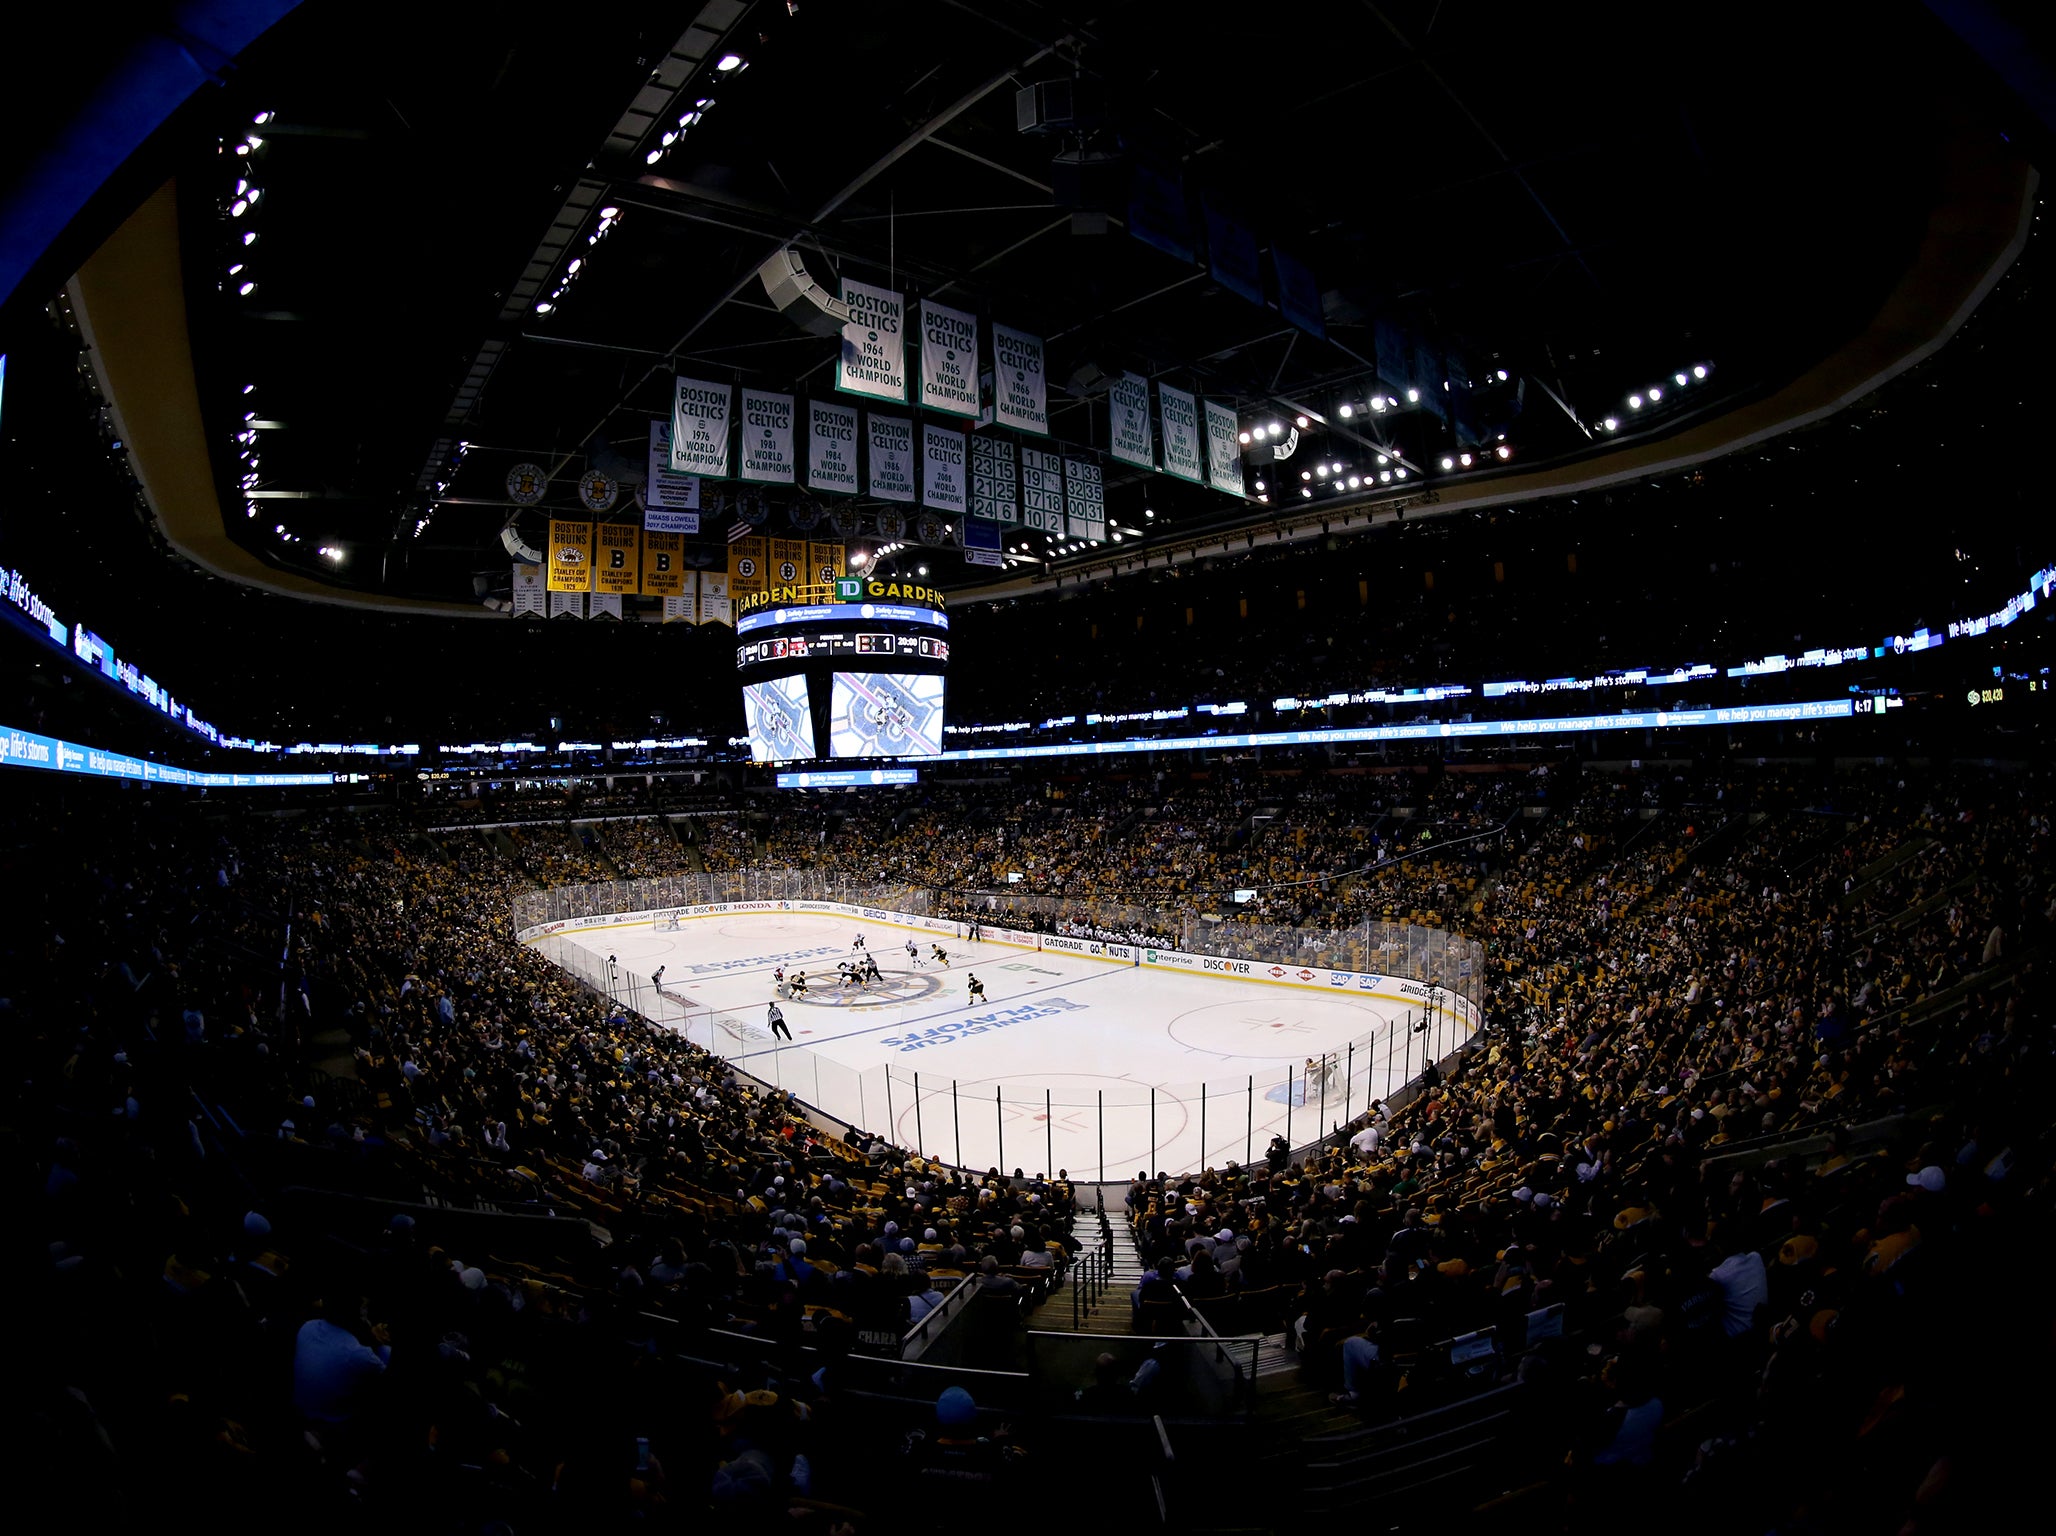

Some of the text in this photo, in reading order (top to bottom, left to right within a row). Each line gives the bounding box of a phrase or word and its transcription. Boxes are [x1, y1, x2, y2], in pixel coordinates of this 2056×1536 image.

[846, 290, 899, 317] BOSTON
[849, 308, 898, 334] CELTICS
[926, 311, 973, 338] BOSTON
[927, 328, 972, 353] CELTICS
[997, 334, 1041, 359] BOSTON
[862, 342, 883, 357] 1964
[856, 354, 891, 372] WORLD
[941, 361, 961, 375] 1965
[1000, 351, 1040, 374] CELTICS
[846, 366, 902, 387] CHAMPIONS
[935, 372, 966, 390] WORLD
[680, 387, 727, 406] BOSTON
[926, 382, 976, 404] CHAMPIONS
[1012, 382, 1030, 395] 1966
[746, 399, 790, 416] BOSTON
[1008, 392, 1036, 409] WORLD
[1113, 390, 1146, 411] CELTICS
[1162, 392, 1193, 414] BOSTON
[681, 402, 724, 420] CELTICS
[813, 409, 854, 428] BOSTON
[1000, 402, 1046, 423] CHAMPIONS
[1164, 407, 1193, 427] CELTICS
[748, 412, 789, 429] CELTICS
[1208, 411, 1236, 431] BOSTON
[692, 430, 710, 441] 1976
[815, 423, 852, 441] CELTICS
[871, 421, 910, 439] BOSTON
[1121, 428, 1144, 444] WORLD
[1210, 425, 1237, 443] CELTICS
[686, 440, 716, 454] WORLD
[760, 439, 776, 449] 1981
[873, 436, 909, 452] CELTICS
[927, 434, 963, 451] BOSTON
[972, 438, 1012, 459] 22 14
[1115, 437, 1151, 456] CHAMPIONS
[676, 451, 724, 466] CHAMPIONS
[754, 450, 783, 462] WORLD
[825, 450, 841, 461] 1984
[928, 449, 962, 465] CELTICS
[1027, 451, 1059, 471] 1 16
[745, 459, 791, 474] CHAMPIONS
[820, 460, 847, 472] WORLD
[884, 461, 900, 471] 1986
[974, 456, 1013, 478] 23 15
[1070, 462, 1100, 482] 3 33
[811, 468, 854, 484] CHAMPIONS
[880, 470, 905, 482] WORLD
[1025, 470, 1040, 486] 19
[872, 479, 913, 493] CHAMPIONS
[934, 481, 957, 493] WORLD
[976, 477, 1015, 499] 21 25
[1068, 481, 1084, 496] 32
[1086, 484, 1102, 499] 35
[927, 489, 963, 505] CHAMPIONS
[1026, 491, 1061, 511] 17 18
[975, 500, 1011, 519] 24 6
[1069, 500, 1103, 520] 00 31
[660, 522, 697, 530] CHAMPIONS
[670, 515, 696, 523] LOWELL
[1027, 511, 1058, 530] 10 2
[554, 523, 588, 535] BOSTON
[602, 526, 634, 537] BOSTON
[554, 533, 587, 545] BRUINS
[602, 536, 634, 548] BRUINS
[648, 540, 679, 551] BRUINS
[774, 541, 802, 551] BOSTON
[732, 546, 762, 557] BRUINS
[774, 550, 802, 561] BRUINS
[814, 545, 841, 555] BOSTON
[814, 554, 841, 565] BRUINS
[552, 574, 586, 584] CHAMPIONS
[553, 568, 573, 577] STANLEY
[601, 576, 633, 586] CHAMPIONS
[10, 568, 31, 612] life's
[30, 593, 55, 629] storms
[740, 585, 797, 612] GARDEN
[838, 580, 943, 604] TD GARDEN
[1949, 623, 1959, 637] We
[883, 638, 890, 650] 1
[1843, 647, 1867, 660] storms
[1503, 683, 1518, 693] We
[1519, 681, 1540, 693] help
[1541, 683, 1558, 693] you
[1560, 680, 1593, 690] manage
[1595, 676, 1613, 687] life's
[1303, 698, 1319, 708] you
[1854, 700, 1872, 713] 4:17
[1716, 710, 1729, 721] We
[1731, 709, 1748, 721] help
[1750, 709, 1766, 721] you
[1767, 706, 1801, 719] manage
[1802, 703, 1823, 716] life's
[1824, 703, 1848, 715] storms
[1500, 722, 1515, 732] We
[1517, 721, 1536, 733] help
[1538, 721, 1556, 733] you
[1558, 719, 1593, 730] manage
[1594, 716, 1614, 727] life's
[1615, 716, 1643, 726] storms
[1297, 732, 1311, 742] We
[1312, 731, 1329, 742] help
[1330, 732, 1345, 742] you
[1346, 730, 1378, 740] manage
[1379, 727, 1398, 737] life's
[1399, 727, 1428, 736] storms
[10, 731, 27, 759] life's
[28, 739, 49, 762] storms
[693, 904, 728, 915] DISCOVER
[733, 902, 771, 910] HONDA
[863, 908, 887, 920] GEICO
[1044, 938, 1083, 951] GATORADE
[1151, 953, 1193, 965] enterprise
[1203, 958, 1250, 974] DISCOVER
[1331, 974, 1349, 984] SAP
[1360, 977, 1378, 987] SAP
[880, 1005, 1037, 1048] PLAYOFFS
[899, 1007, 1062, 1053] STANLEY CUP
